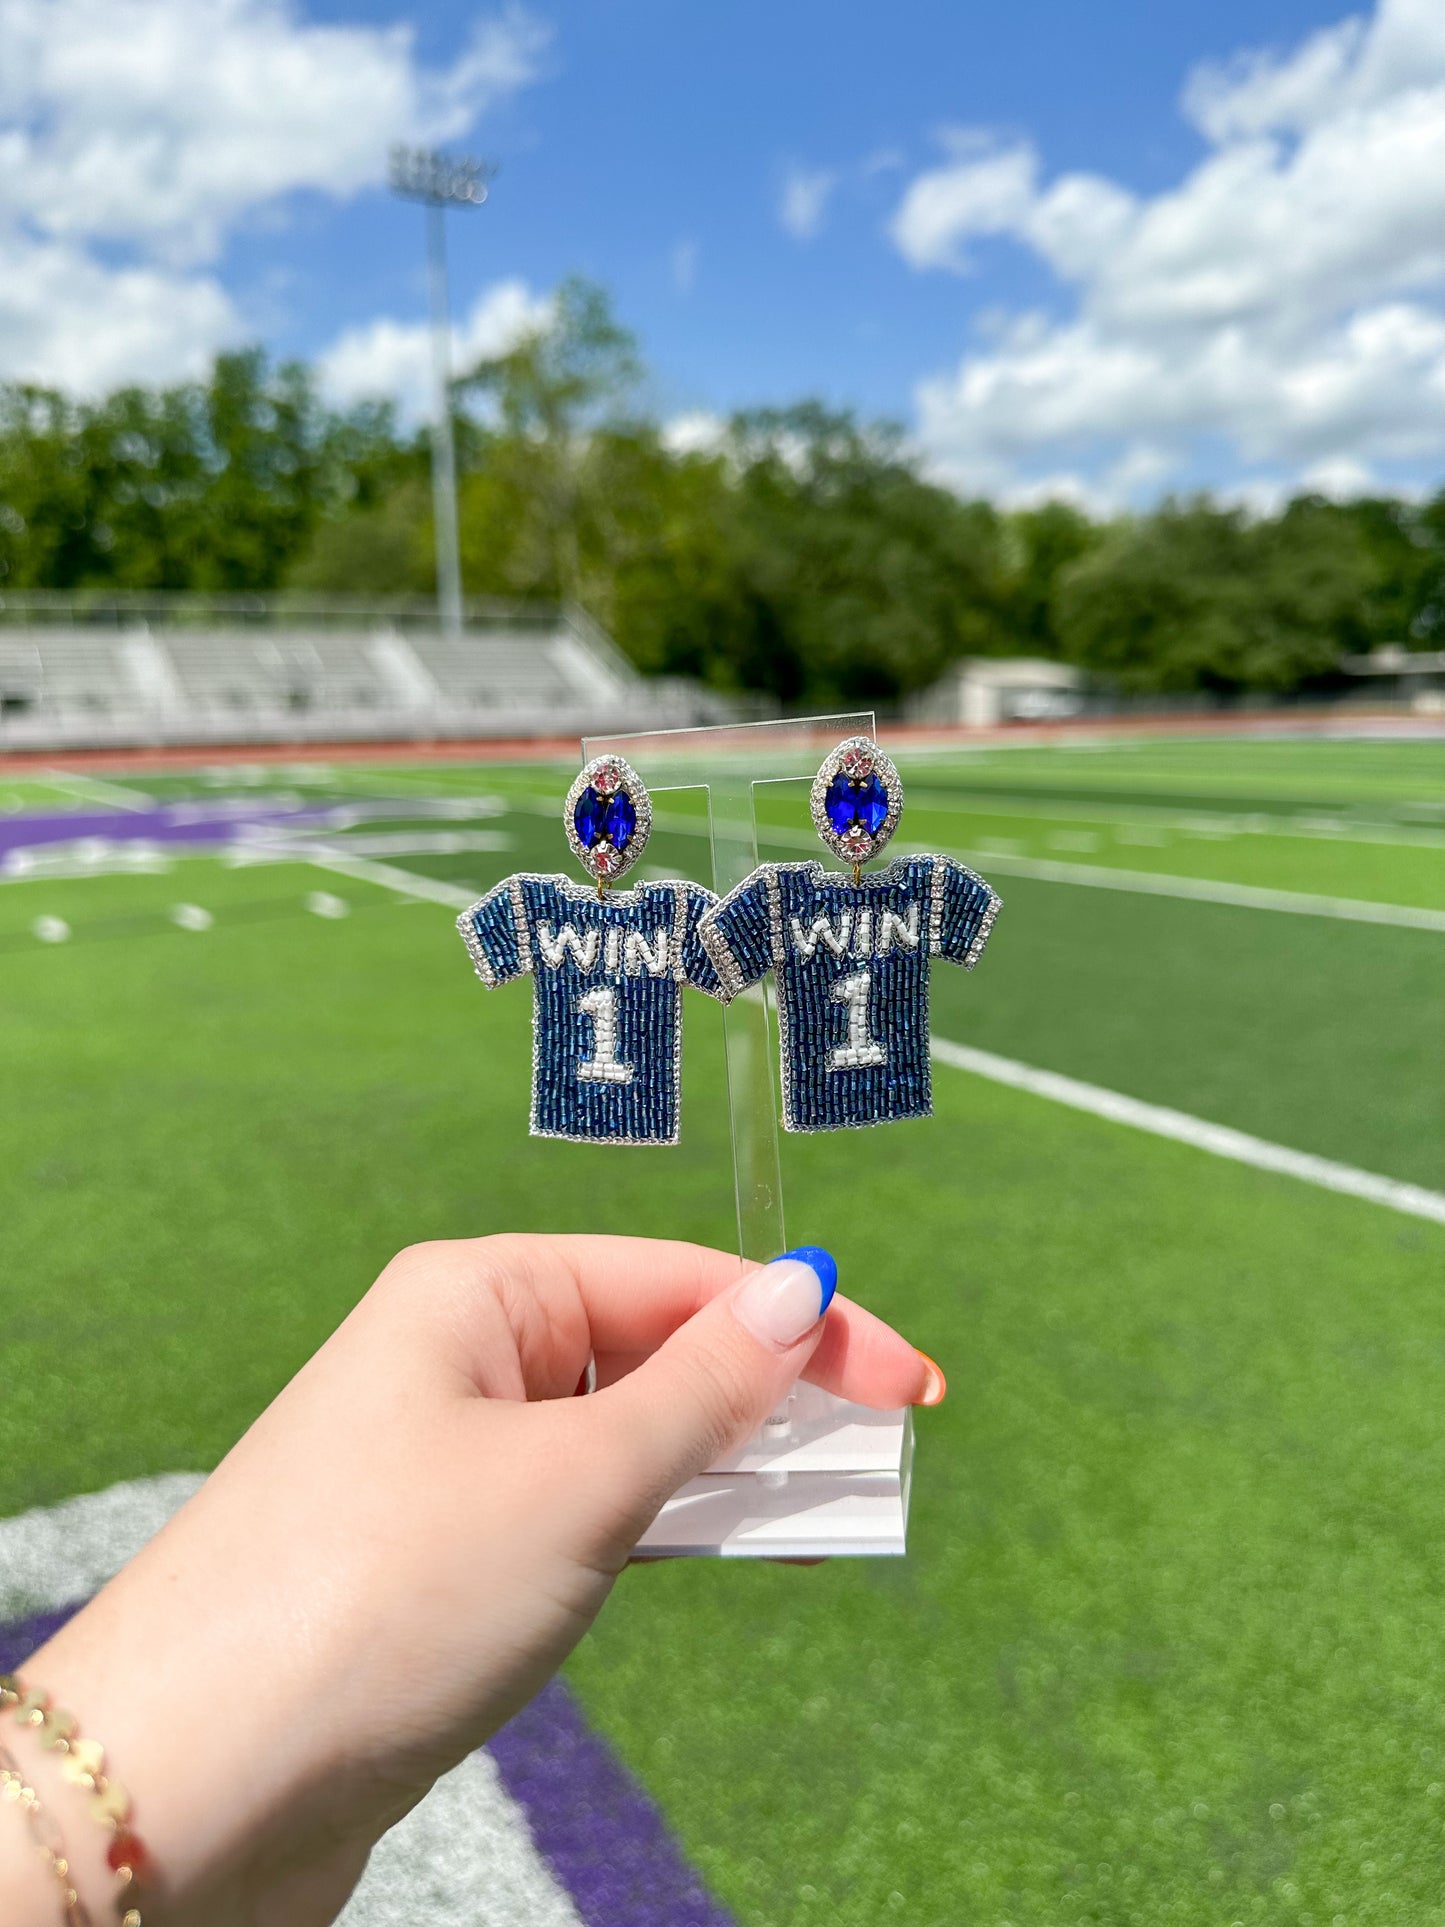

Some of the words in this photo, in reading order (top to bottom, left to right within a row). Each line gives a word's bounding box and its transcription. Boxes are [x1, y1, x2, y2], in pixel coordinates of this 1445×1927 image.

[537, 922, 669, 975] WIN
[791, 905, 919, 960] WIN
[577, 986, 634, 1084] 1
[825, 972, 888, 1071] 1
